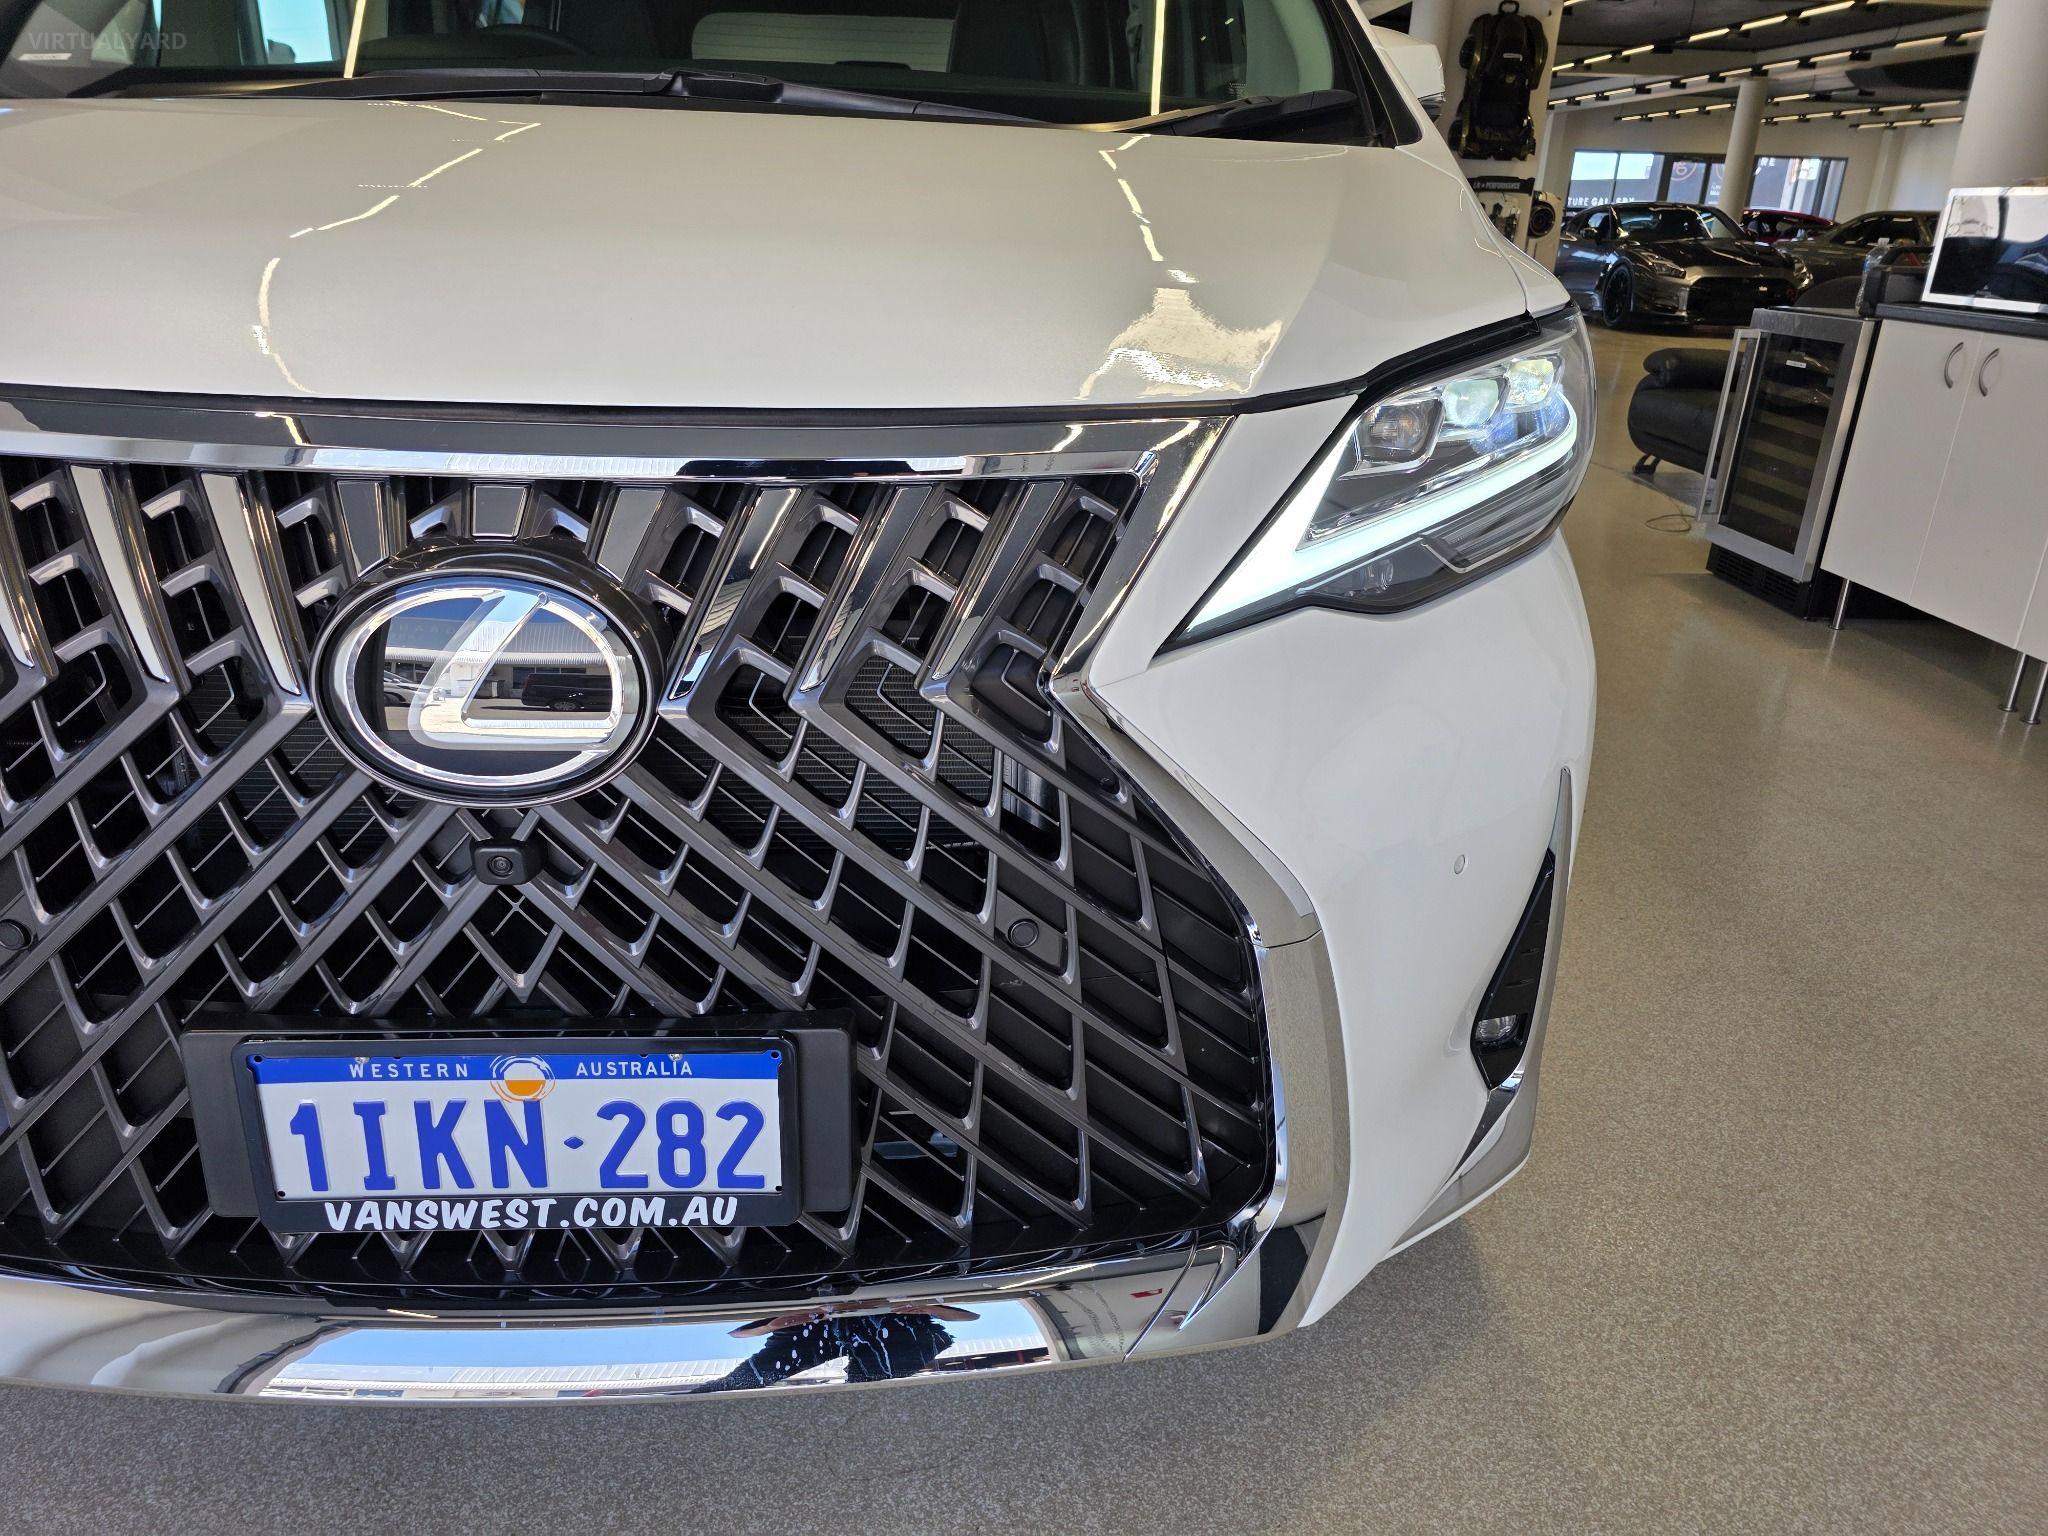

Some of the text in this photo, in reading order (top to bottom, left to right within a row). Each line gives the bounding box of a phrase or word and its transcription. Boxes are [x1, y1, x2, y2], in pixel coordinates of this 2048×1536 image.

[350, 1060, 694, 1079] WESTERN AUSTRALIA
[324, 1196, 738, 1232] VANSWEST.COM.AU
